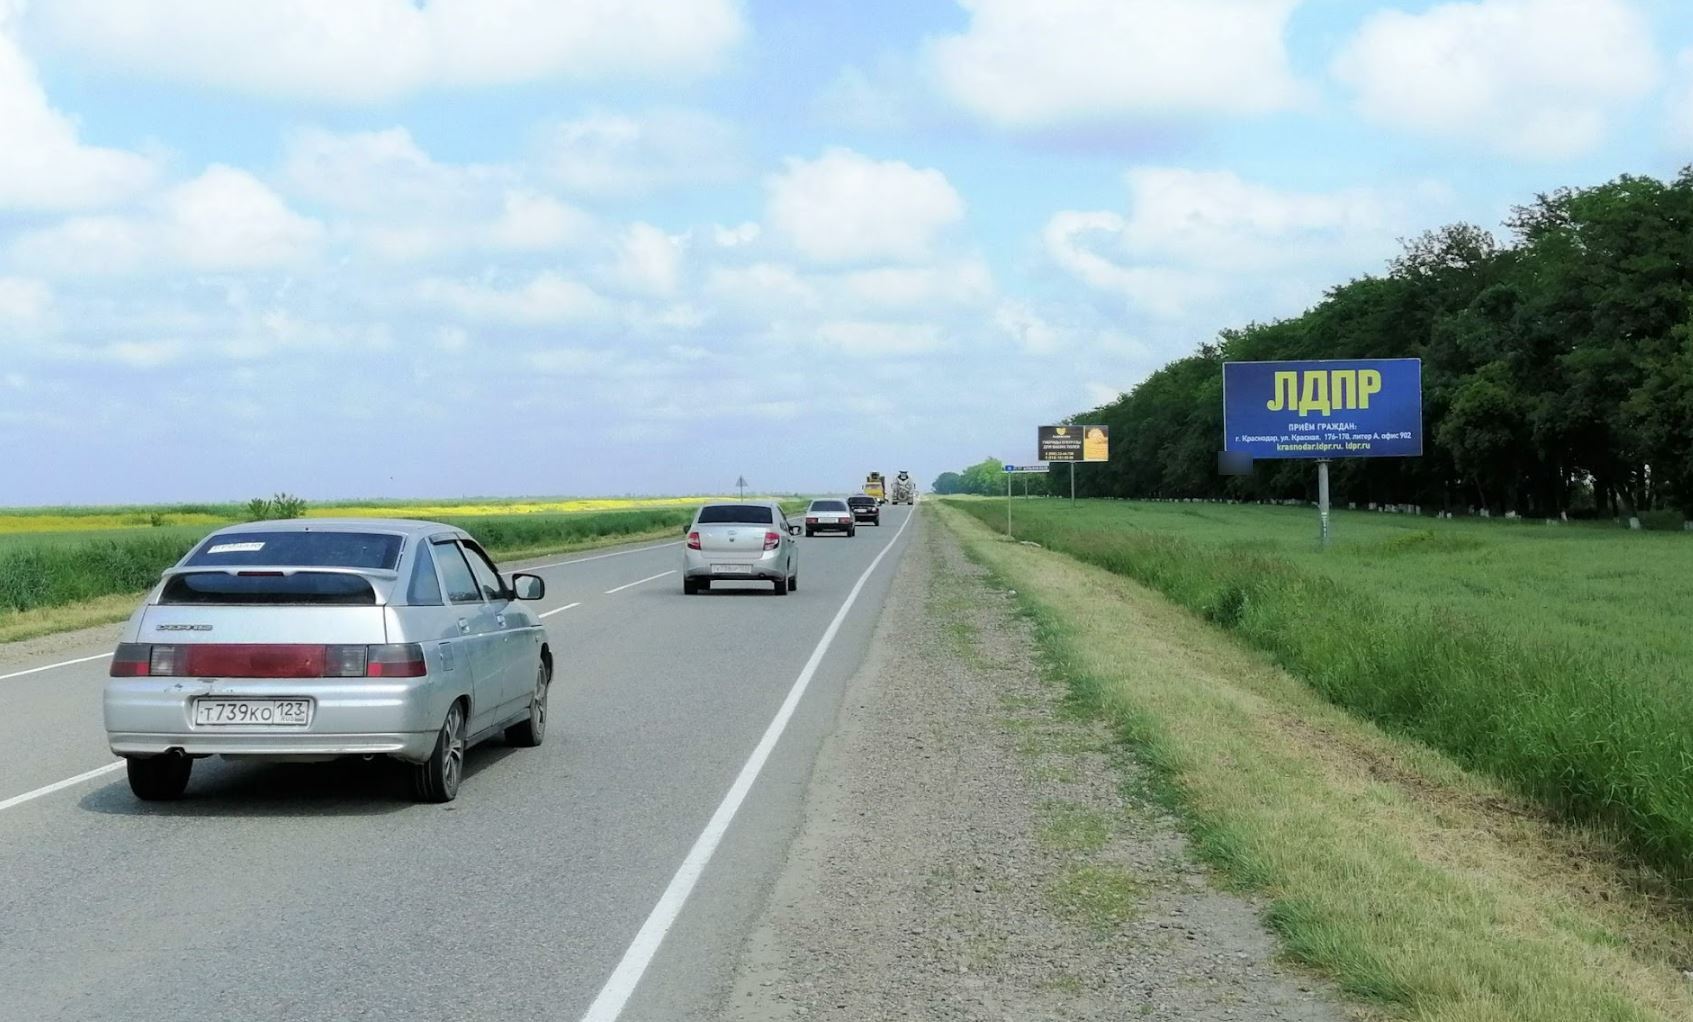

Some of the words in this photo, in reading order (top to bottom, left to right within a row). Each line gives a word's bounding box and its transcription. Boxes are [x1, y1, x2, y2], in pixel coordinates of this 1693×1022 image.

[1266, 369, 1382, 417] ЛДПР
[1288, 422, 1315, 431] ПРИЁМ
[1317, 422, 1357, 431] ГРАЖДАН:
[277, 702, 303, 716] 123
